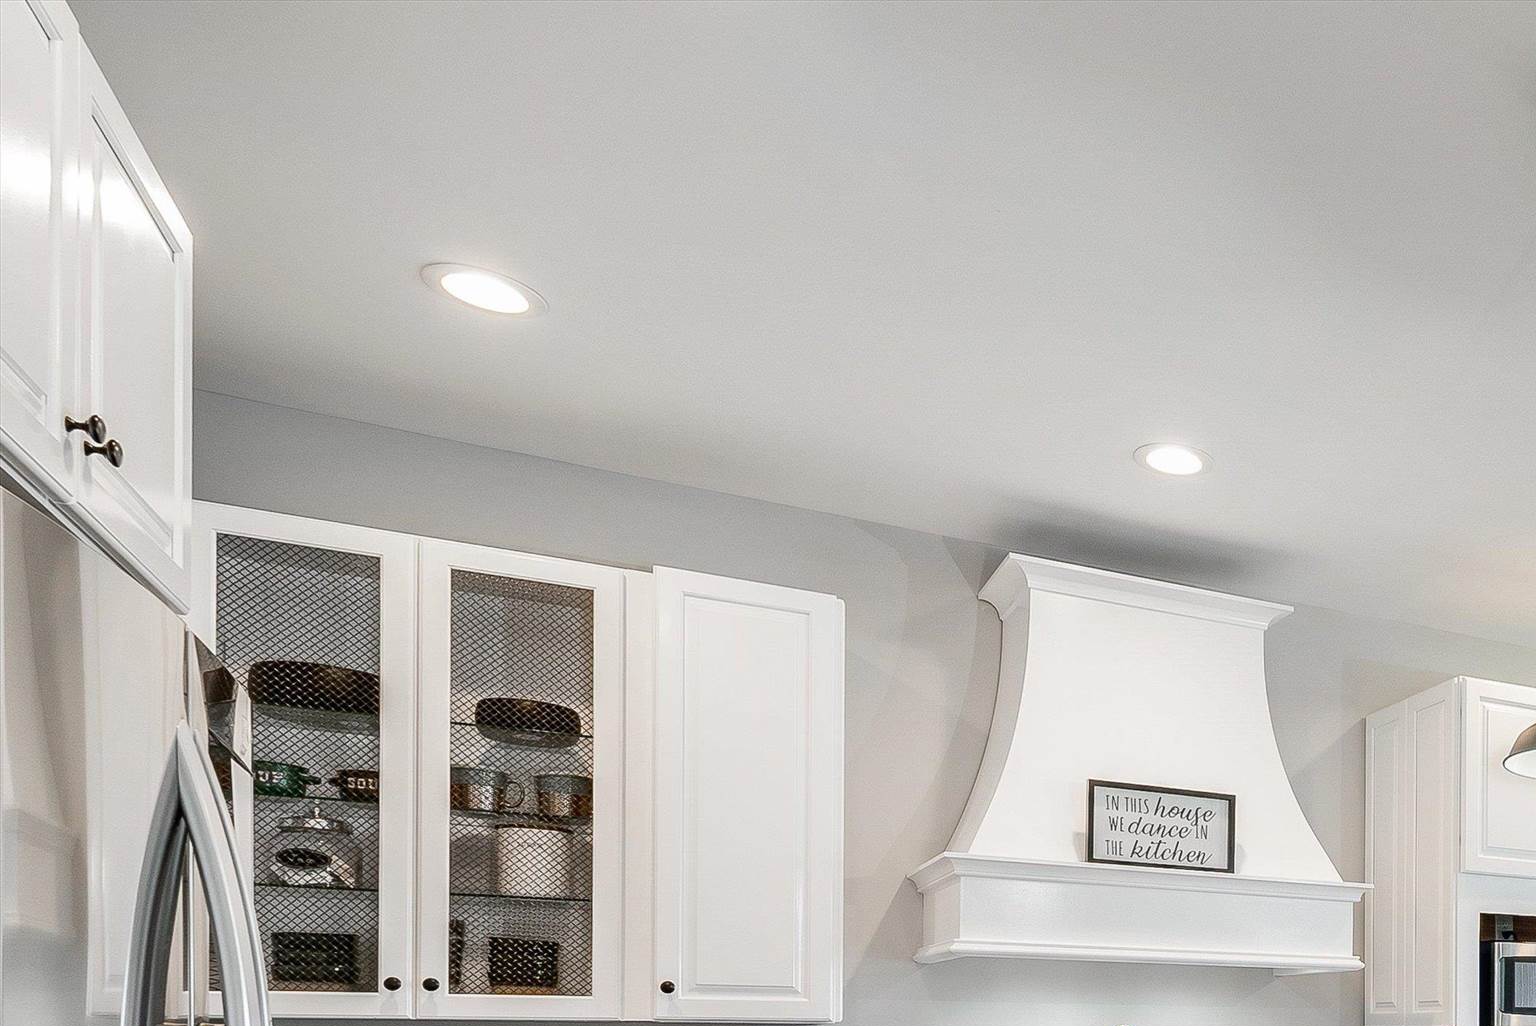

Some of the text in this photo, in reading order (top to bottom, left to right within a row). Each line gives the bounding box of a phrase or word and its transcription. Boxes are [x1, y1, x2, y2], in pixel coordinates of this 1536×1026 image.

[347, 777, 378, 789] SOU
[1105, 794, 1216, 827] IN THIS house
[1108, 815, 1208, 840] WE dance IN
[1105, 839, 1213, 865] THE kitchen
